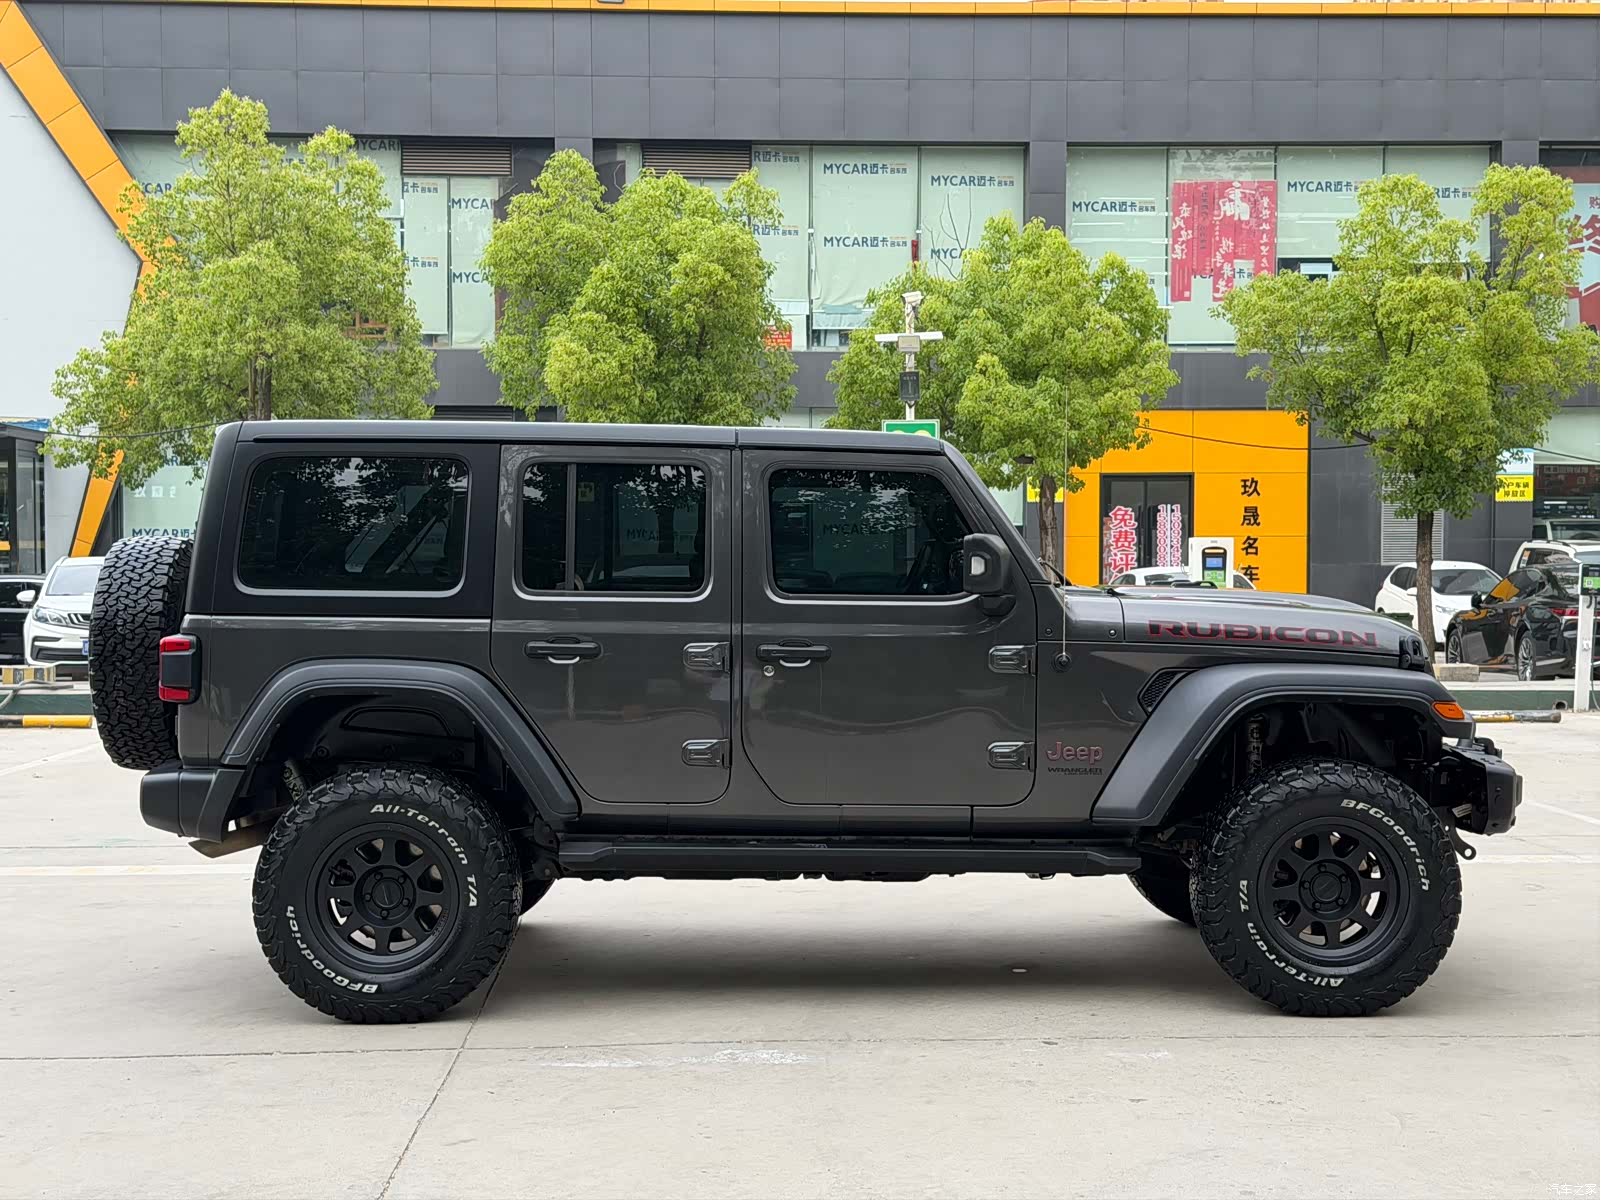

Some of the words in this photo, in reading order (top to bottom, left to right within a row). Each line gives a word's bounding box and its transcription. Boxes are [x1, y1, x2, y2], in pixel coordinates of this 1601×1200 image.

[451, 198, 492, 209] MYCA
[1109, 506, 1138, 584] 免费评
[1240, 477, 1261, 583] 玖晟名车
[1148, 619, 1377, 647] RUBICON
[1047, 741, 1103, 765] Jeep
[369, 804, 468, 865] All-Terrain
[466, 874, 478, 907] T/A
[1340, 798, 1430, 891] BFGoodrich
[1238, 879, 1249, 913] T/A
[286, 905, 379, 994] BFGoodrich
[1246, 922, 1345, 988] All-Terrain
